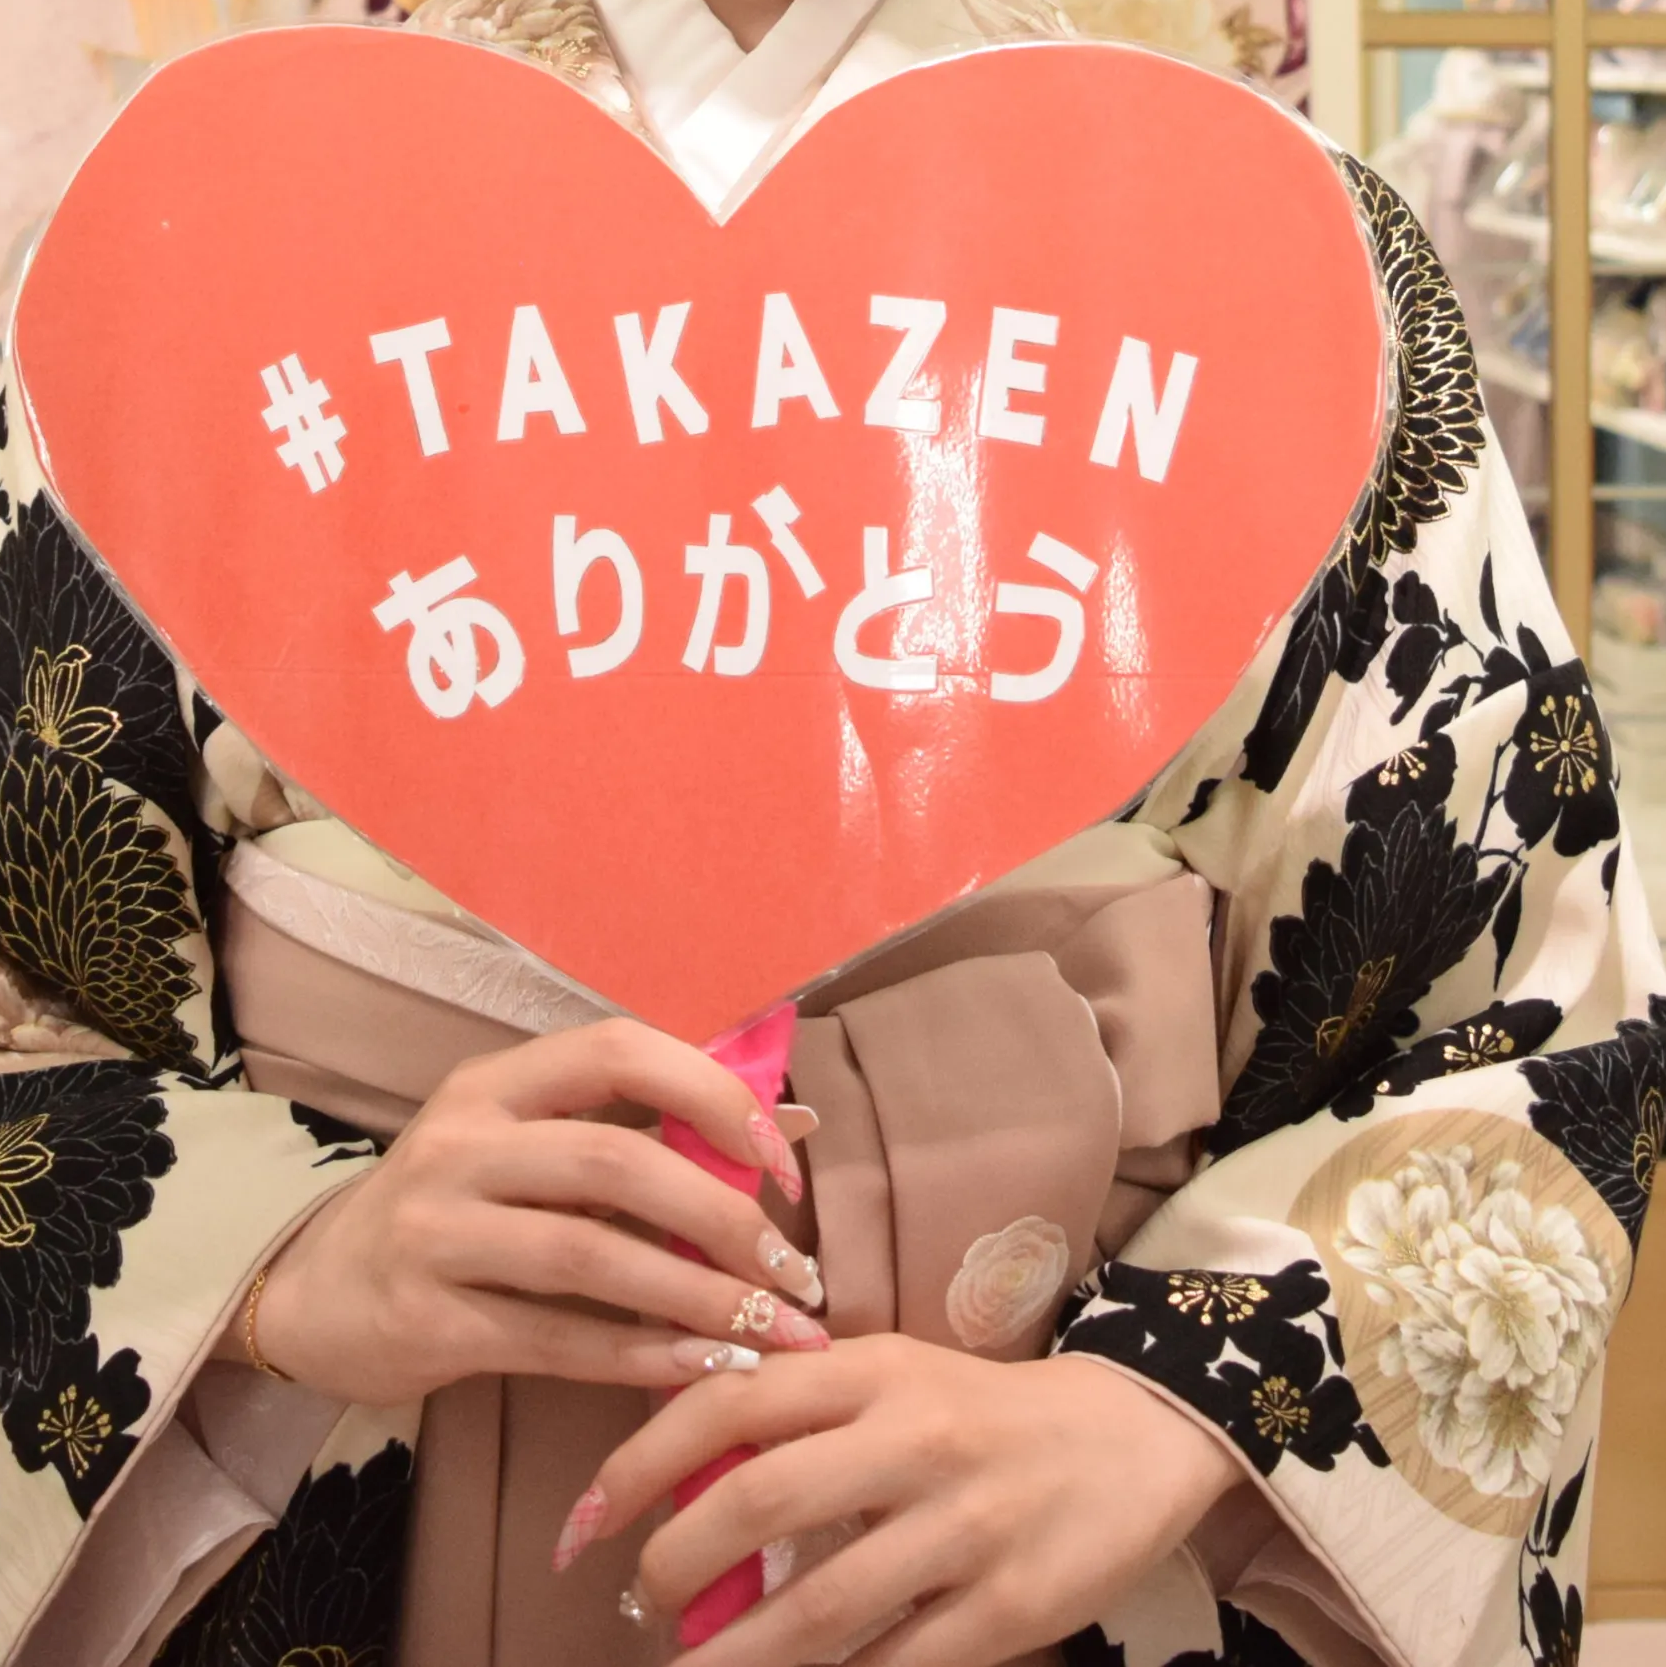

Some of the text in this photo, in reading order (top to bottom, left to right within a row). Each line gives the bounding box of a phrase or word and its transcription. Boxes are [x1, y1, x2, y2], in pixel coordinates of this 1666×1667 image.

[260, 292, 1198, 494] #TAKAZEN
[372, 485, 1098, 719] ありがとう
